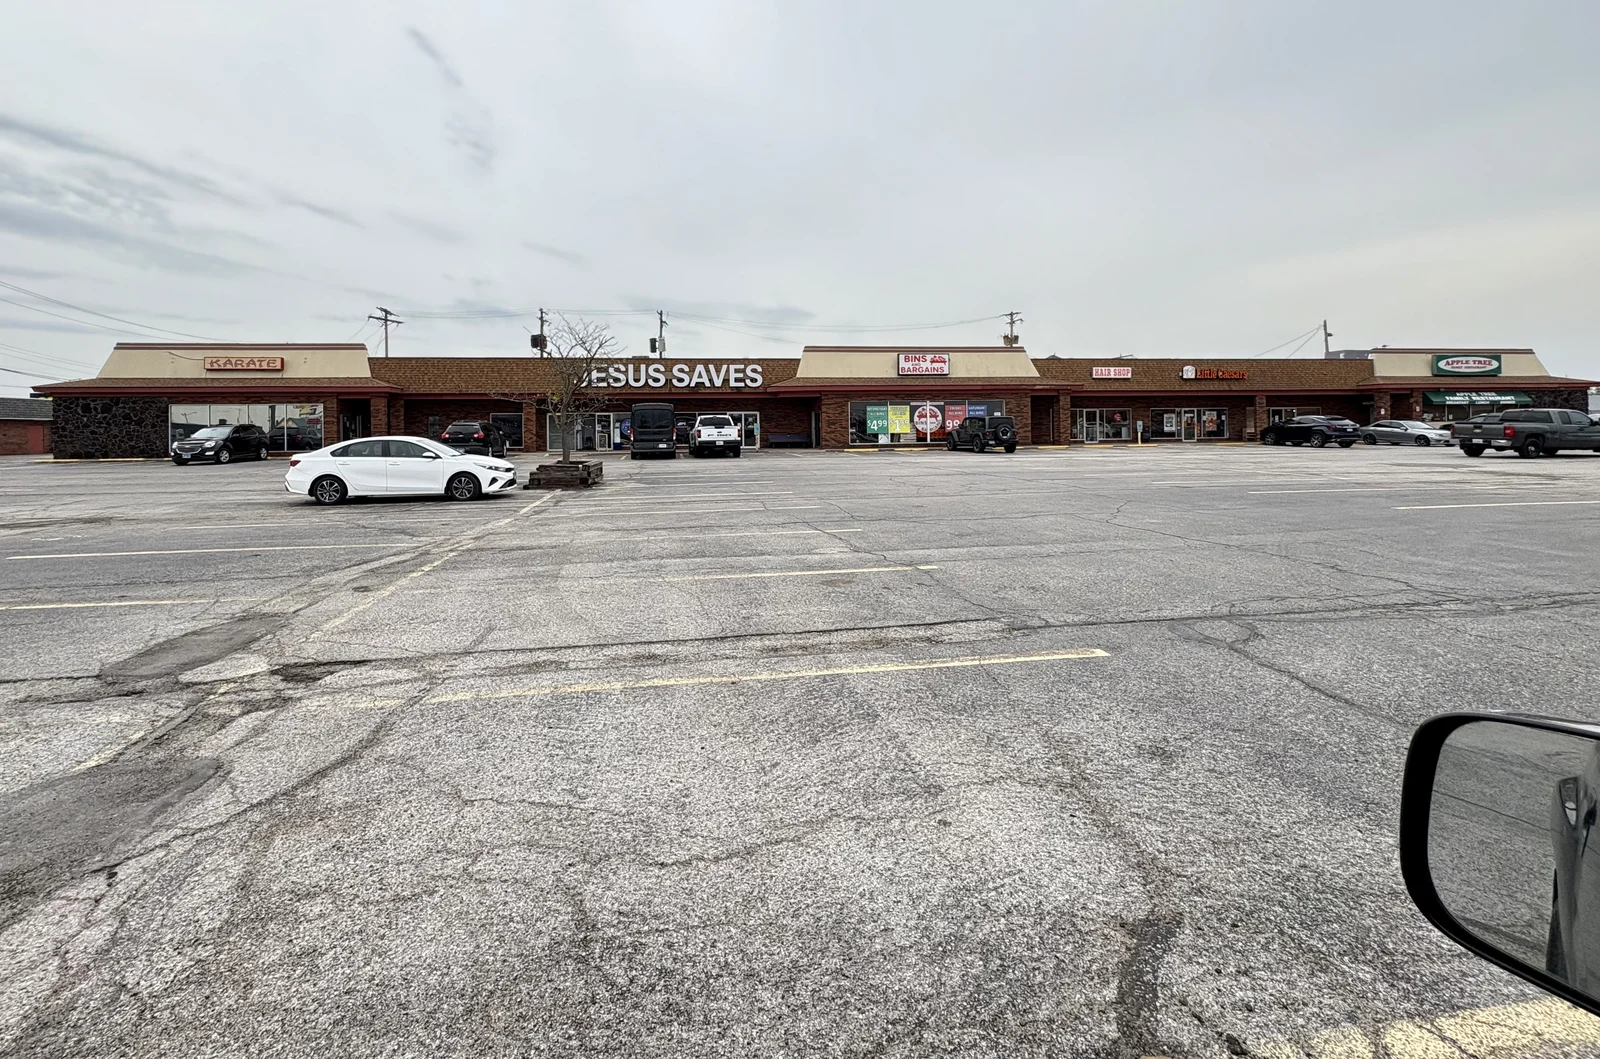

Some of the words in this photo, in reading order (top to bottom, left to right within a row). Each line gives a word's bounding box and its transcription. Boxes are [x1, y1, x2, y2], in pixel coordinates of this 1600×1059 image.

[209, 358, 278, 368] KARATE
[904, 355, 927, 363] BINS
[1444, 359, 1470, 367] APPLE
[1472, 359, 1493, 367] TREE
[671, 364, 763, 388] SAVES
[1094, 368, 1112, 377] HAIR
[1113, 368, 1131, 377] SHOP
[1196, 368, 1217, 379] Little
[1218, 368, 1248, 379] Caesars
[867, 419, 887, 431] $499
